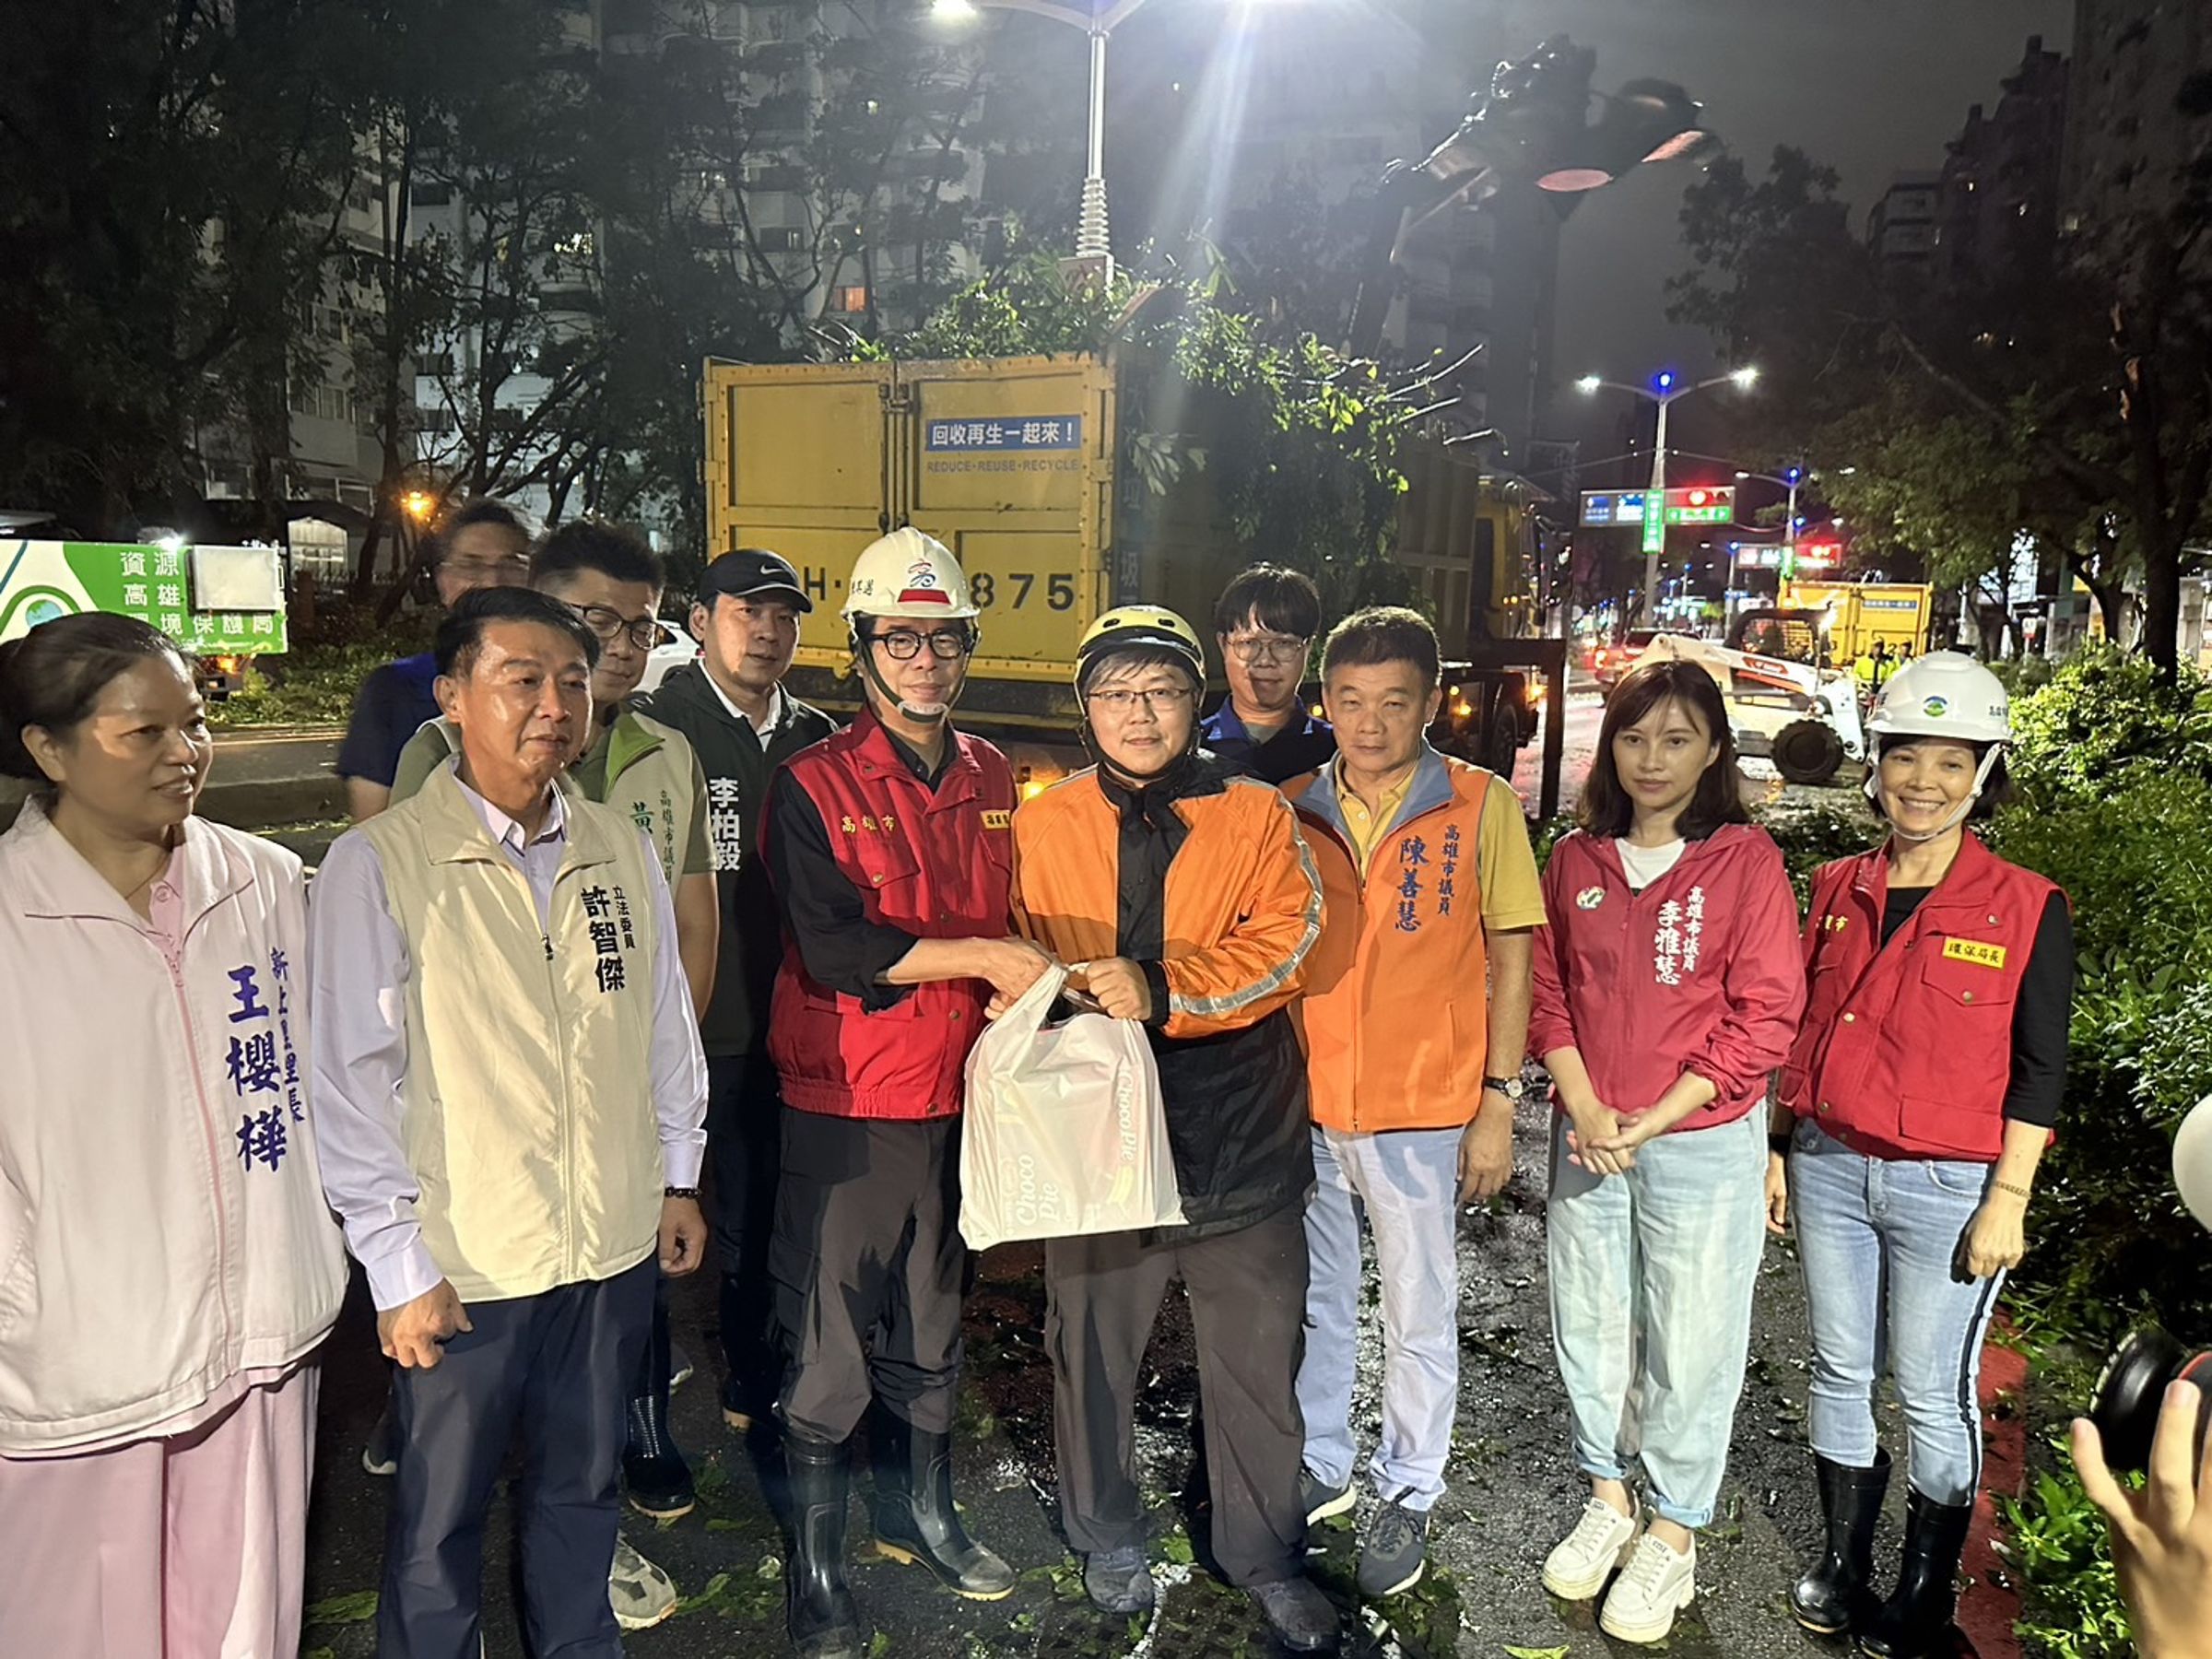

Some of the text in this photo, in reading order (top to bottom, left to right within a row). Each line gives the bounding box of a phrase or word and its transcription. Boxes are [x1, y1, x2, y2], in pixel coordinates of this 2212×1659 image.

[932, 422, 1073, 446] 回收再生一起來！
[120, 551, 180, 577] 資源
[124, 583, 180, 606] 高雄
[1395, 835, 1430, 932] 陳善慧
[1438, 824, 1460, 916] 高雄市議員
[581, 886, 625, 994] 許智傑
[612, 885, 636, 949] 立法委員
[1682, 886, 1705, 972] 高雄市議員
[226, 965, 288, 1172] 王櫻樺
[1016, 1154, 1038, 1226] Choco
